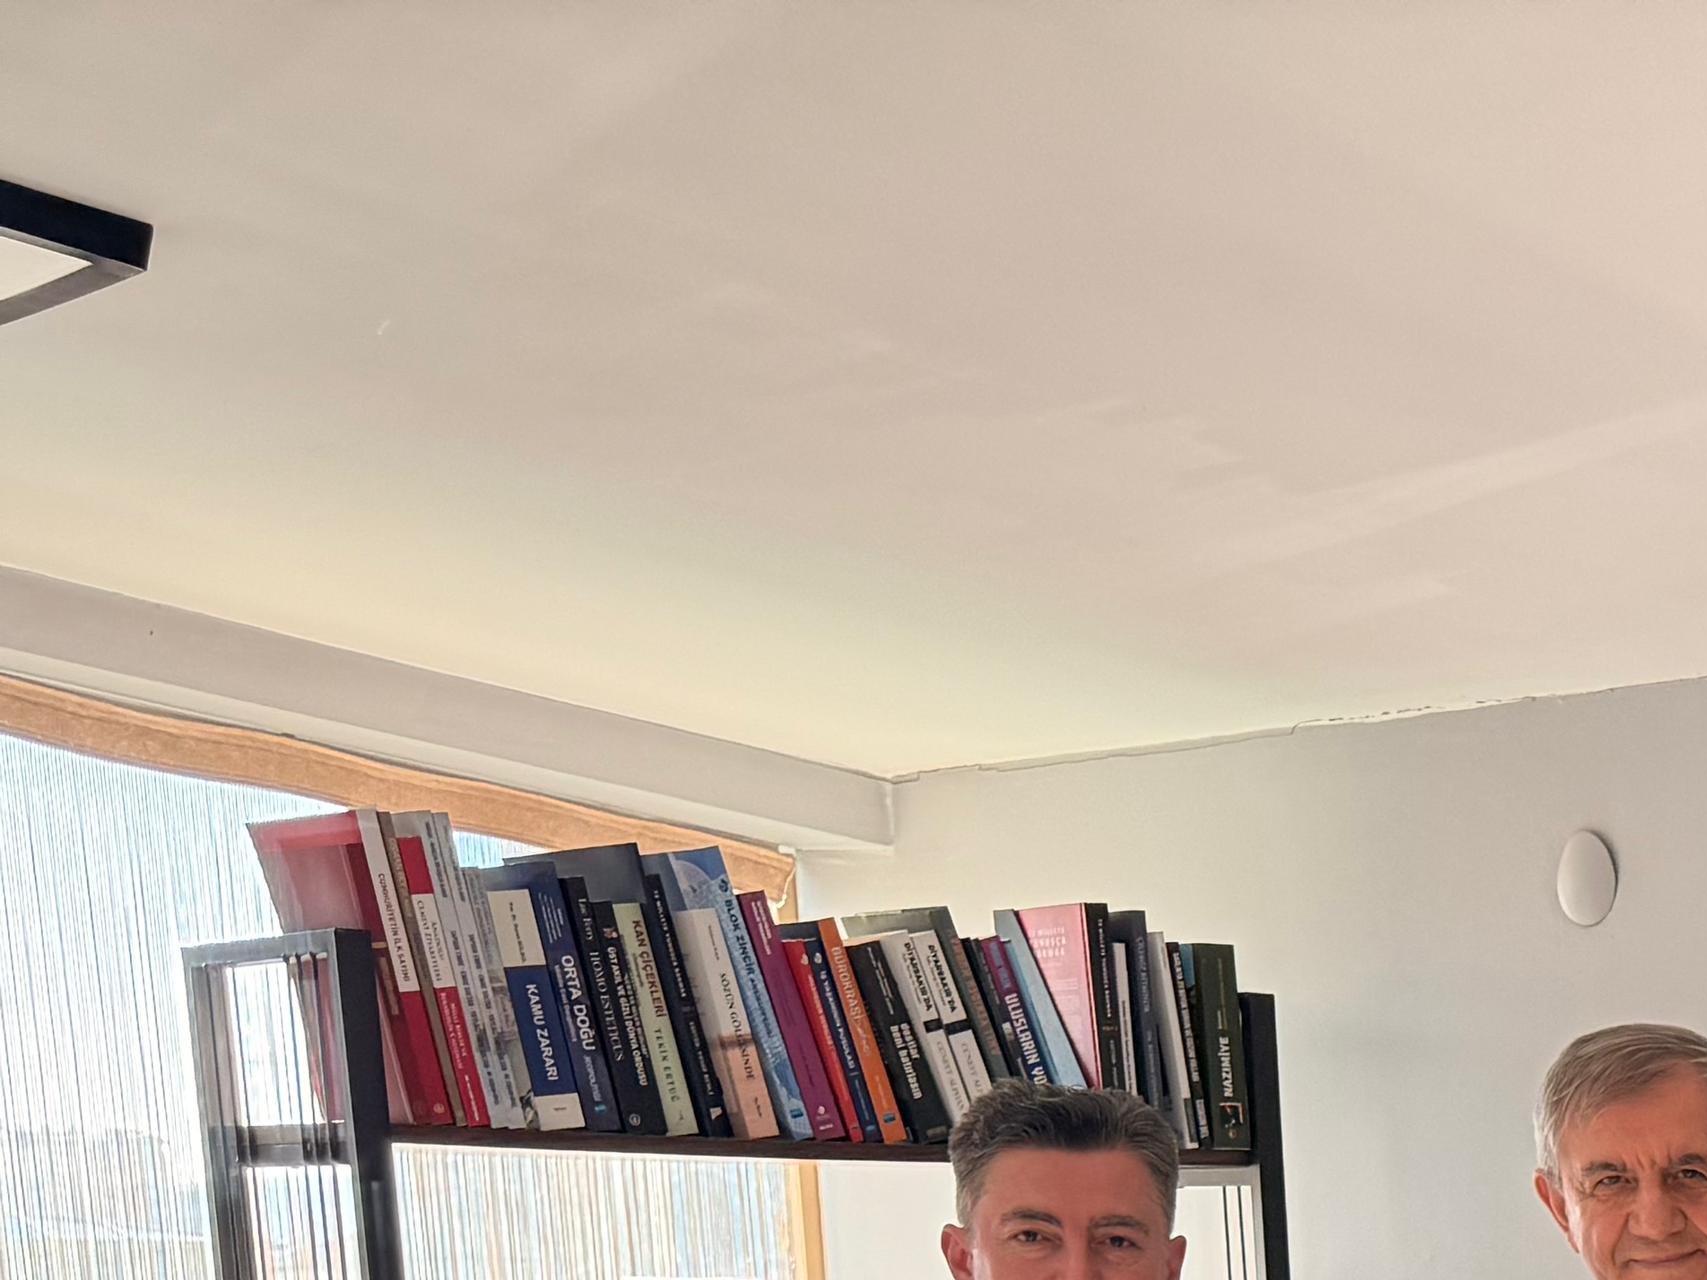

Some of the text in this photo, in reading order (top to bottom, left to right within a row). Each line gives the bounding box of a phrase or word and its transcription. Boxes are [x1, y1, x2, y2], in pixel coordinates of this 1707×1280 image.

[631, 918, 647, 948] KAN
[723, 898, 757, 976] BLOK ZİNCİR
[559, 952, 599, 1051] ORTA DOĞU
[588, 950, 625, 1062] HOMO ESTETICUS
[637, 949, 667, 1019] ÇİÇEKLERİ
[524, 982, 559, 1081] KAMU ZARARI
[623, 1019, 640, 1050] DÜNYA
[718, 971, 755, 1081] SÖZÜN GÖLGESİNDE
[899, 1021, 922, 1061] dostlar
[1002, 992, 1041, 1065] ULUSLARIN
[630, 1048, 648, 1086] ORDUSU
[1217, 1035, 1233, 1097] NAZIMİYE
